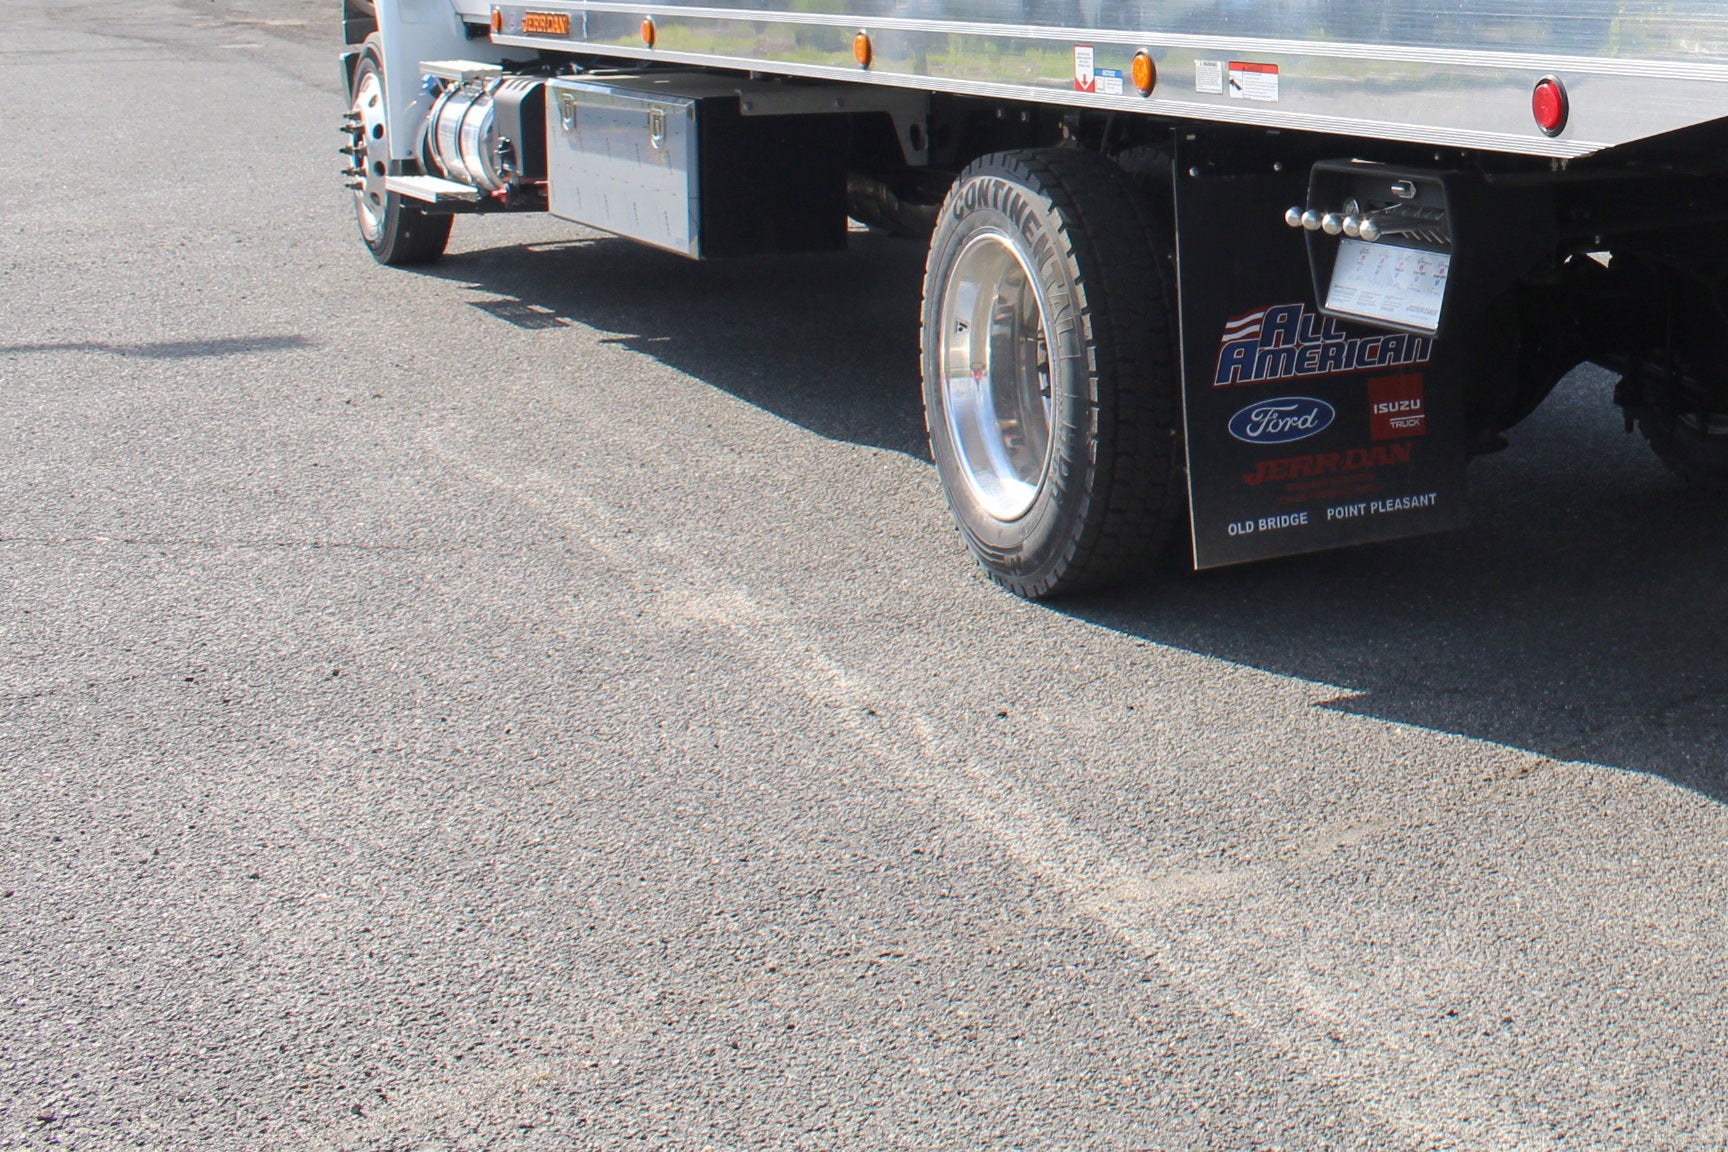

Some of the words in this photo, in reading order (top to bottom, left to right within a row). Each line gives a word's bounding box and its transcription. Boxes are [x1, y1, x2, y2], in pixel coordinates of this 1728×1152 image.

[953, 177, 1081, 359] CONTINENTAL
[1259, 303, 1347, 349] ALL
[1214, 333, 1433, 386] AMERICAN
[1246, 404, 1320, 437] Ford
[1373, 399, 1421, 414] ISUZU
[1389, 418, 1421, 429] TRUCK
[1228, 520, 1254, 536] OLD
[1258, 512, 1308, 531] BRIDGE
[1327, 503, 1366, 520] POINT
[1370, 493, 1437, 514] PLEASANT
